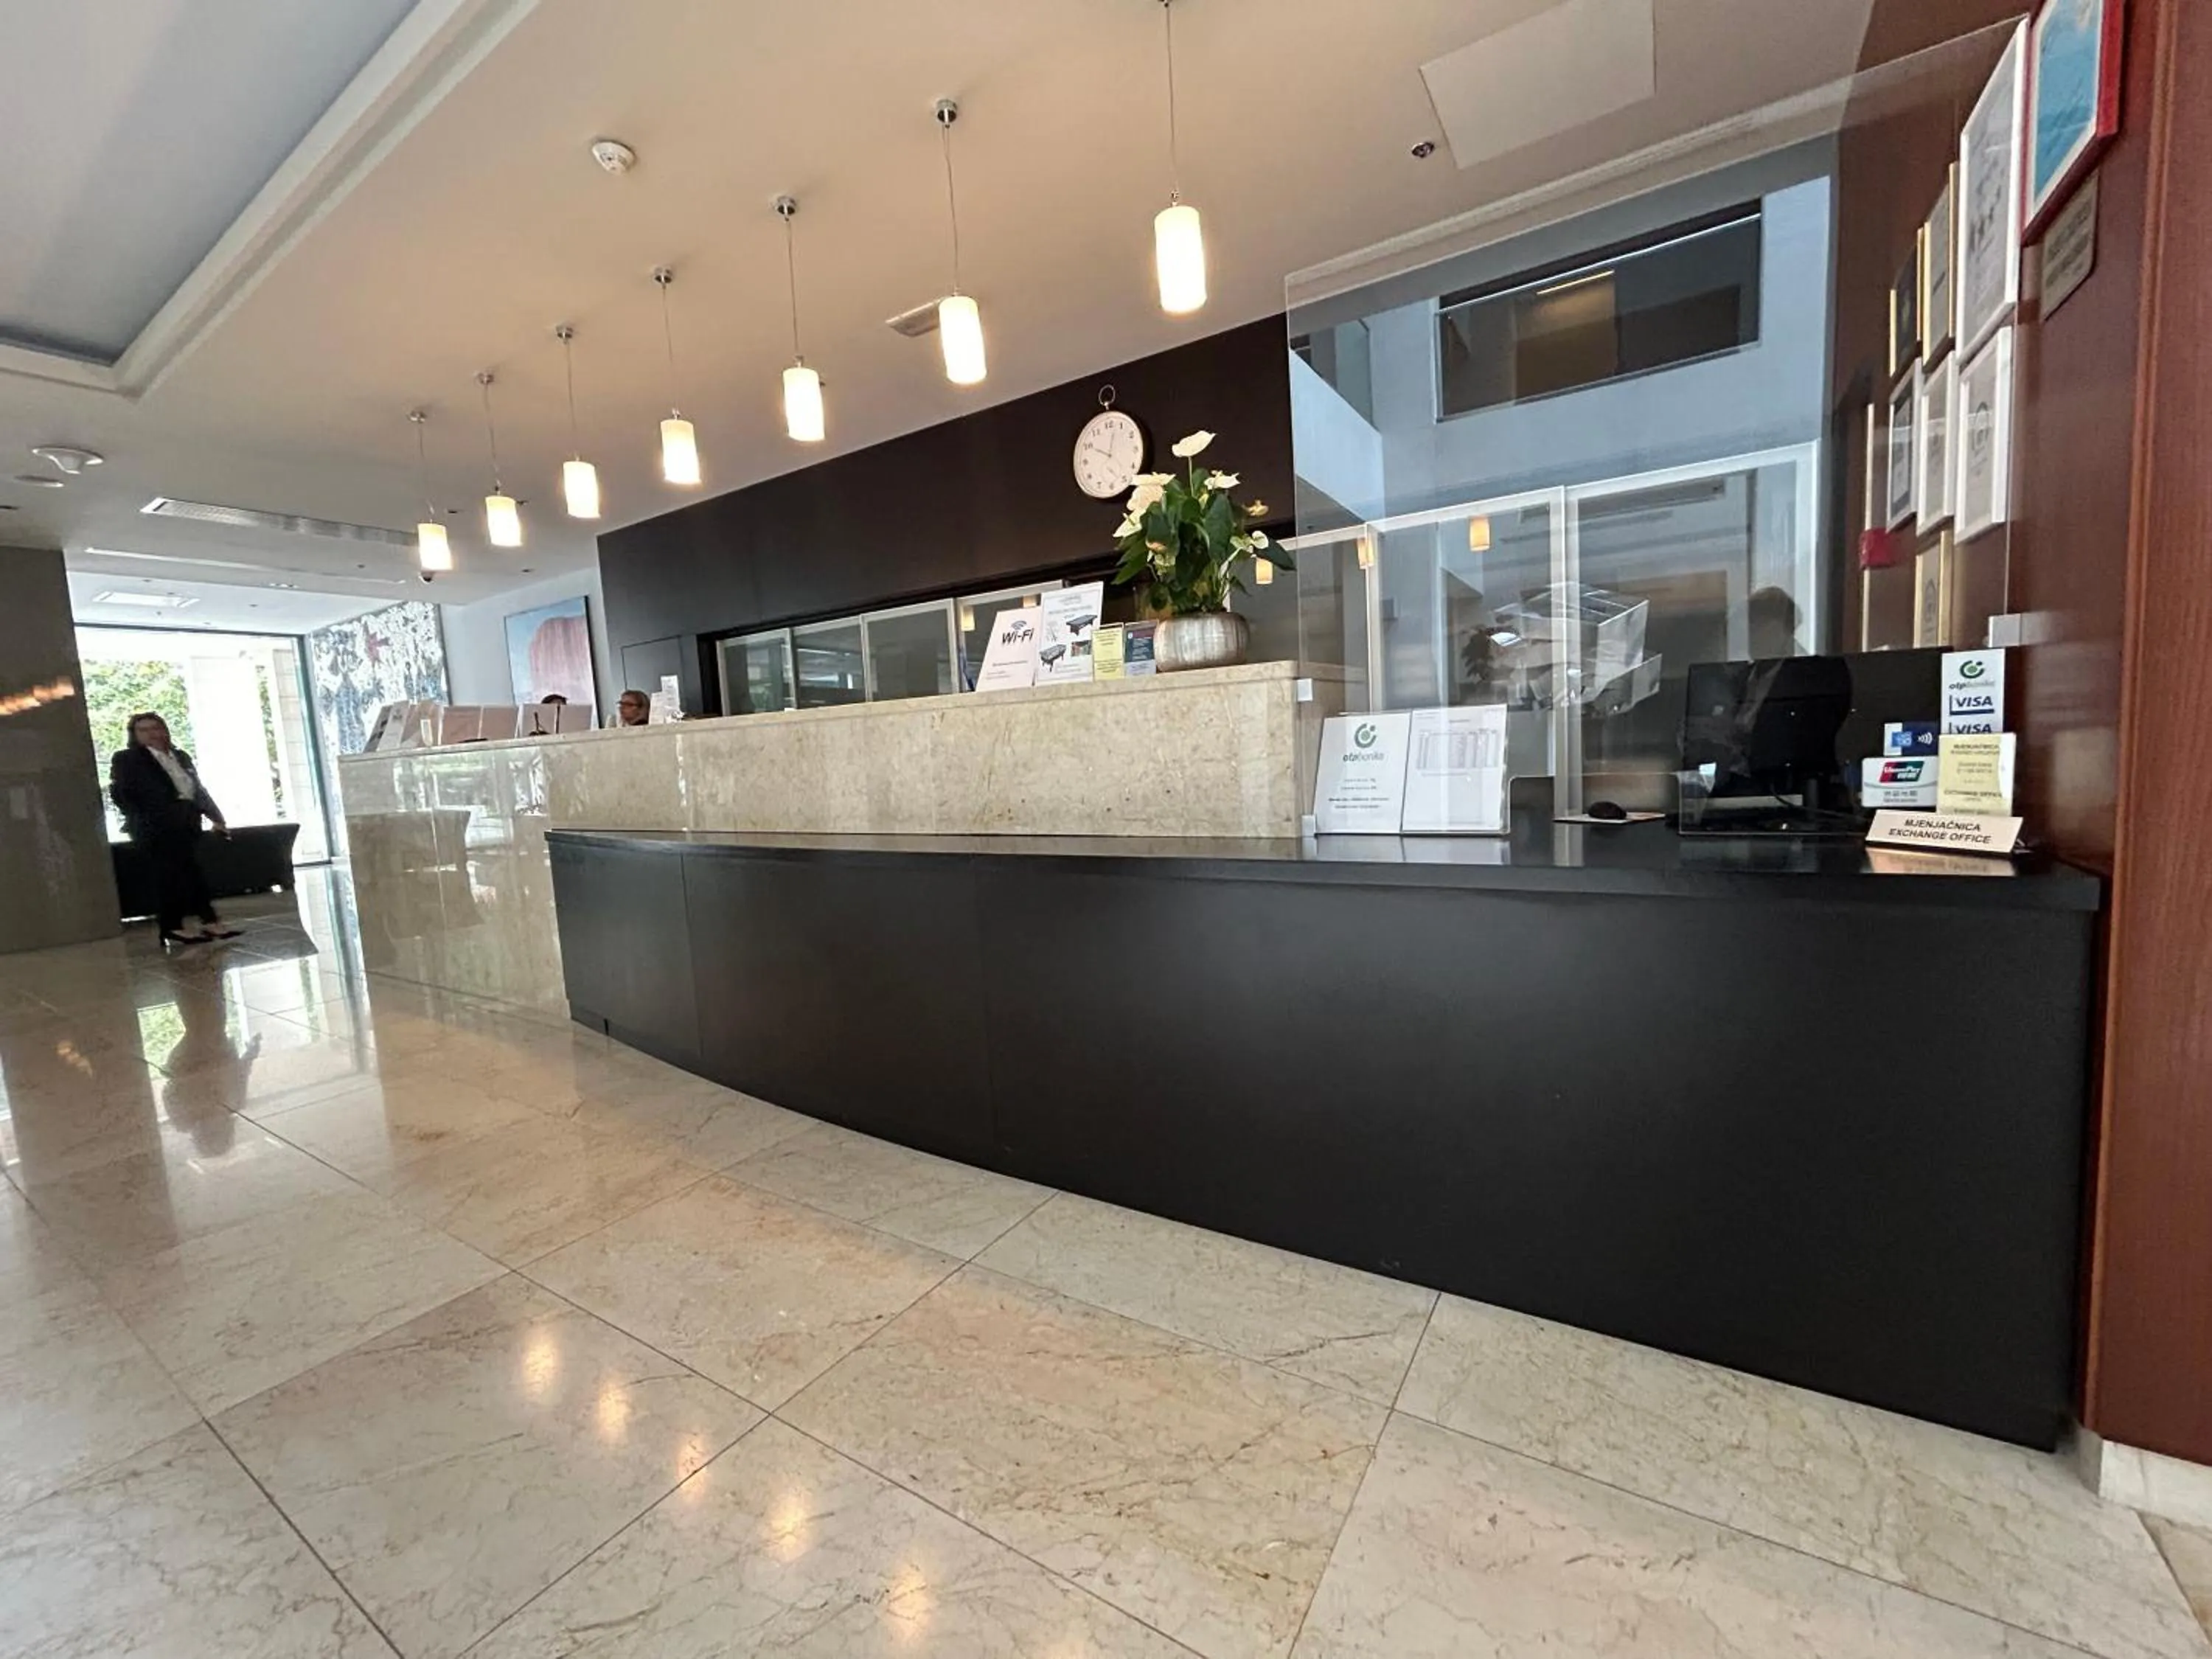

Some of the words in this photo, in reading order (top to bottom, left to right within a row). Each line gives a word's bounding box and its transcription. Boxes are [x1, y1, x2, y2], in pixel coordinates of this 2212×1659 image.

[1105, 420, 1114, 429] 12
[1091, 428, 1101, 437] 11
[1083, 442, 1093, 451] 10
[1002, 628, 1034, 644] Wi-Fi
[1955, 696, 1993, 707] VISA
[1955, 723, 1992, 734] VISA
[1905, 818, 1981, 832] MJENJAČNICA
[1888, 828, 1949, 840] EXCHANGE
[1949, 832, 1992, 844] OFFICE
